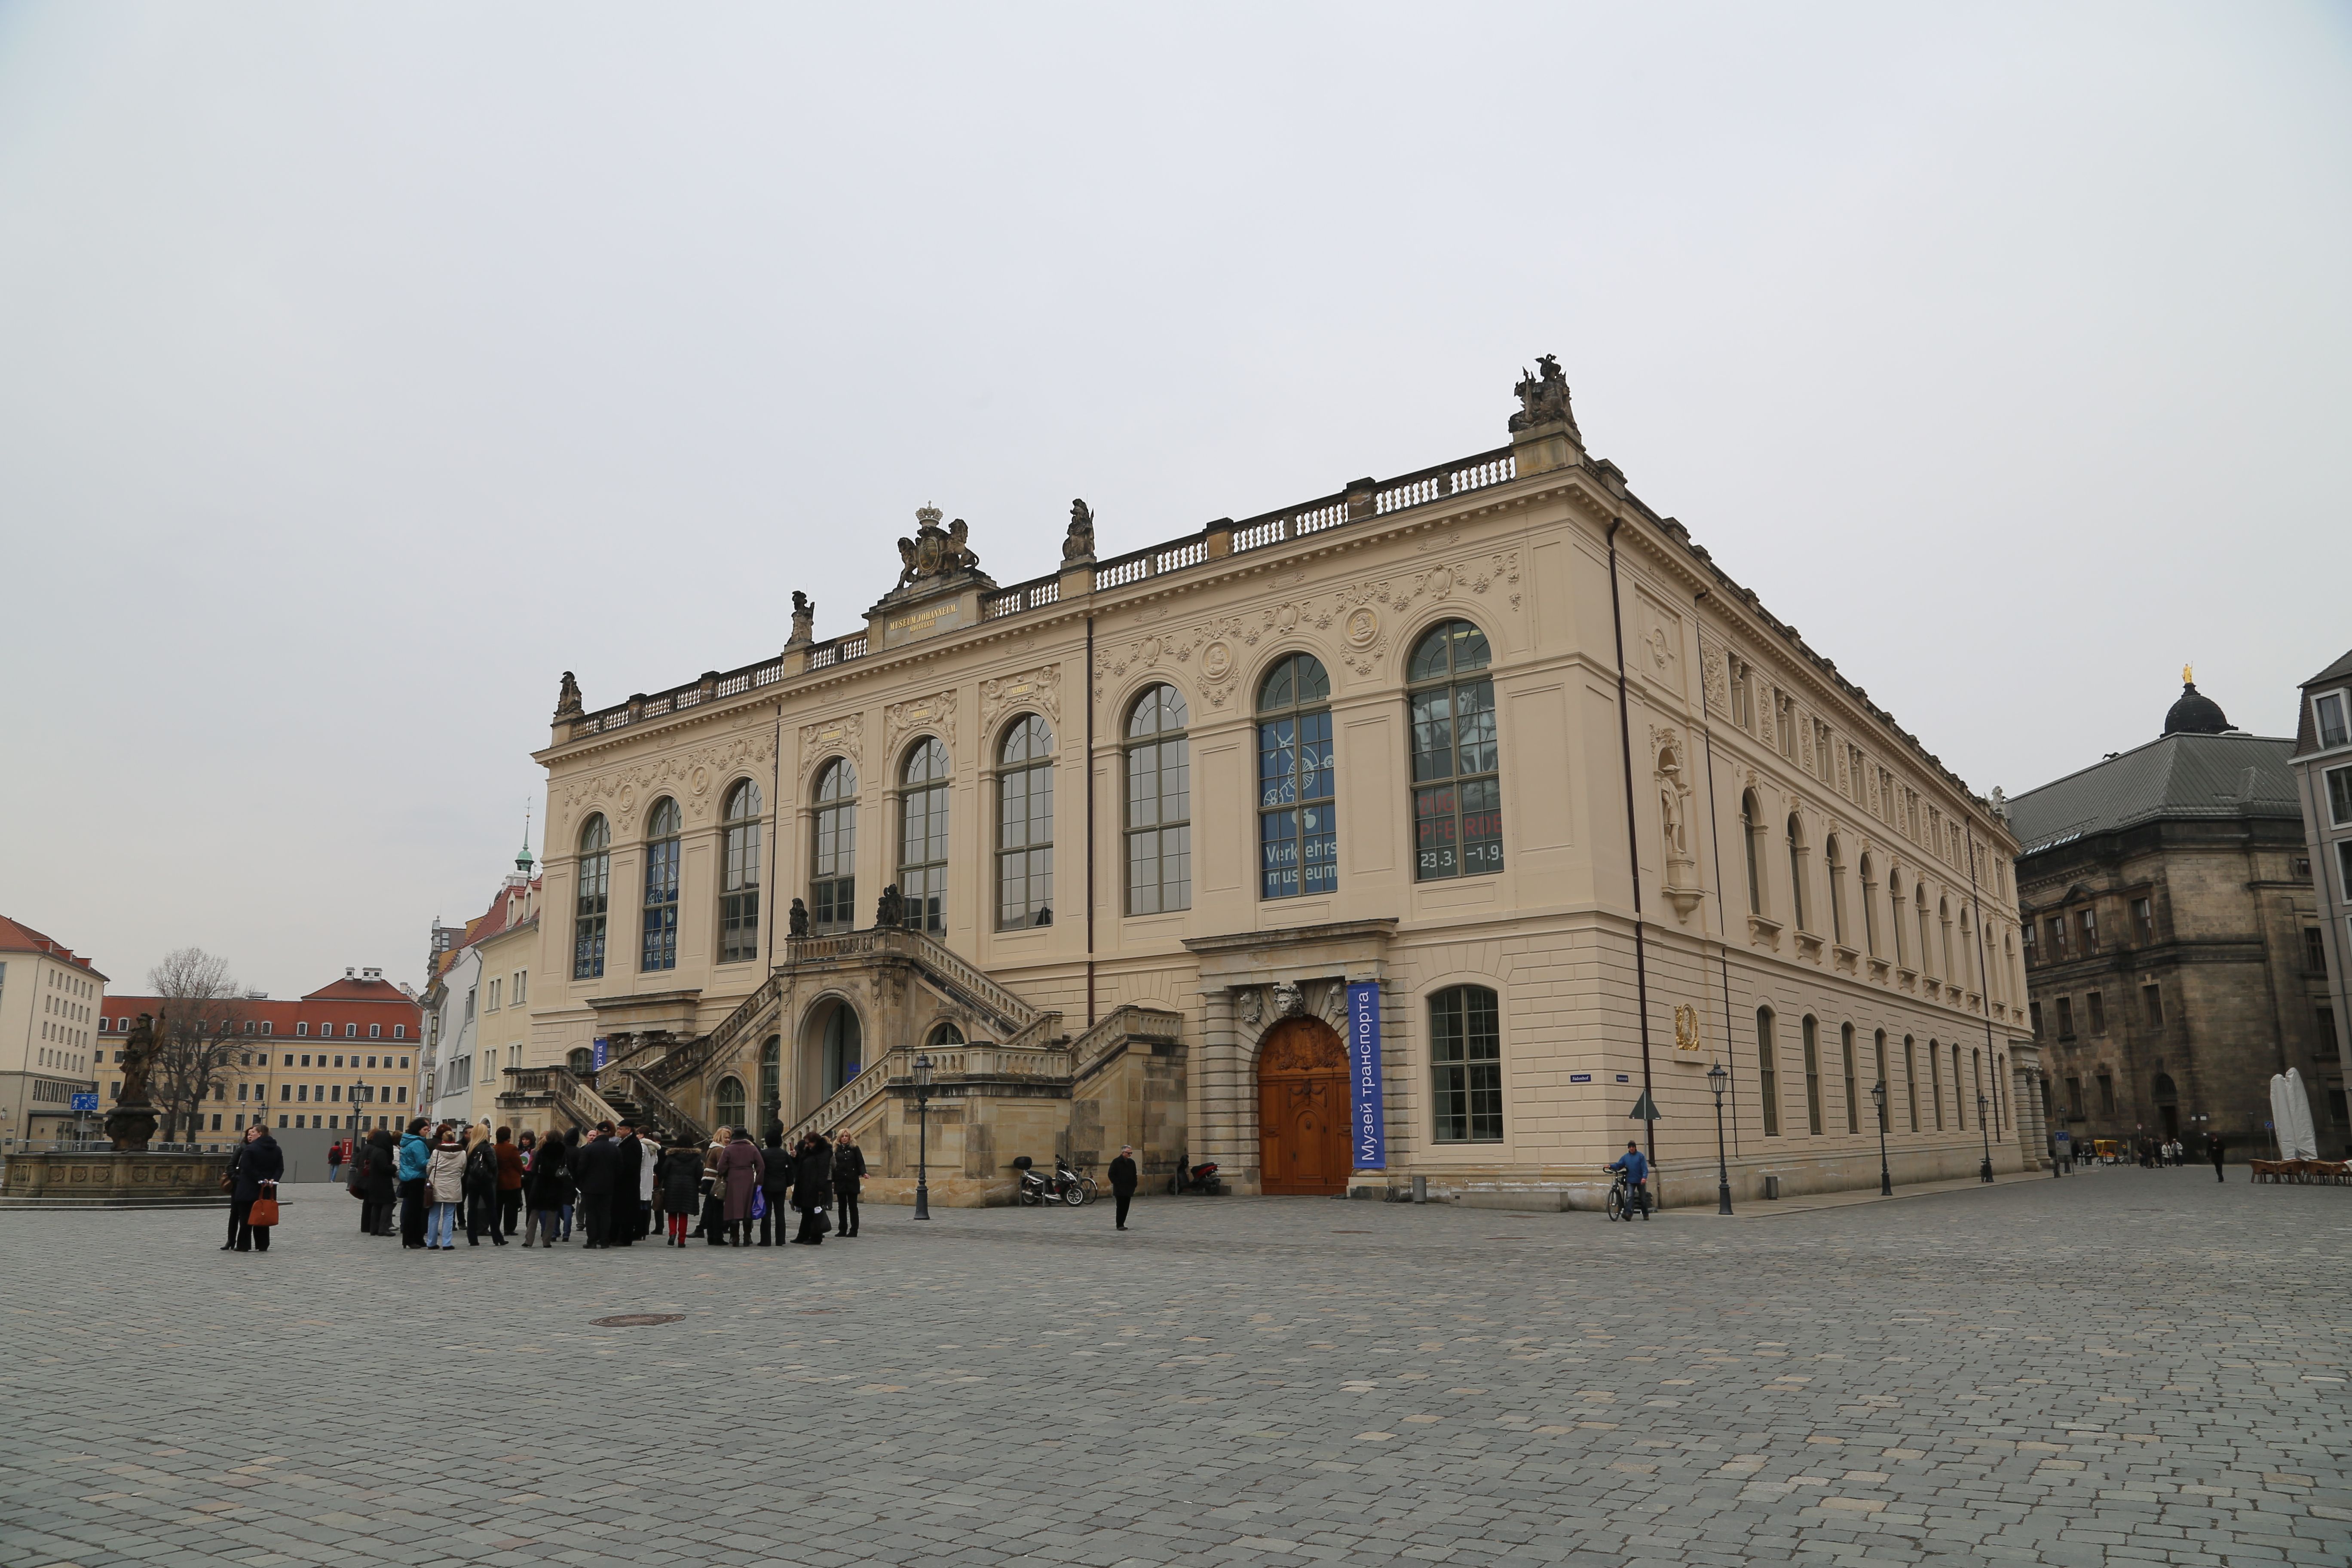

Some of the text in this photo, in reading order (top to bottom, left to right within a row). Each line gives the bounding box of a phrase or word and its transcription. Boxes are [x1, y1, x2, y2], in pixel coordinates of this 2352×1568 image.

[890, 604, 958, 631] MUSEUM JOHANNEUM.
[1419, 793, 1455, 815] ZUG
[1420, 813, 1502, 842] PFERDE
[1266, 840, 1336, 863] Verkehrs
[1268, 865, 1337, 885] museum
[1359, 991, 1377, 1160] Музей транспорта
